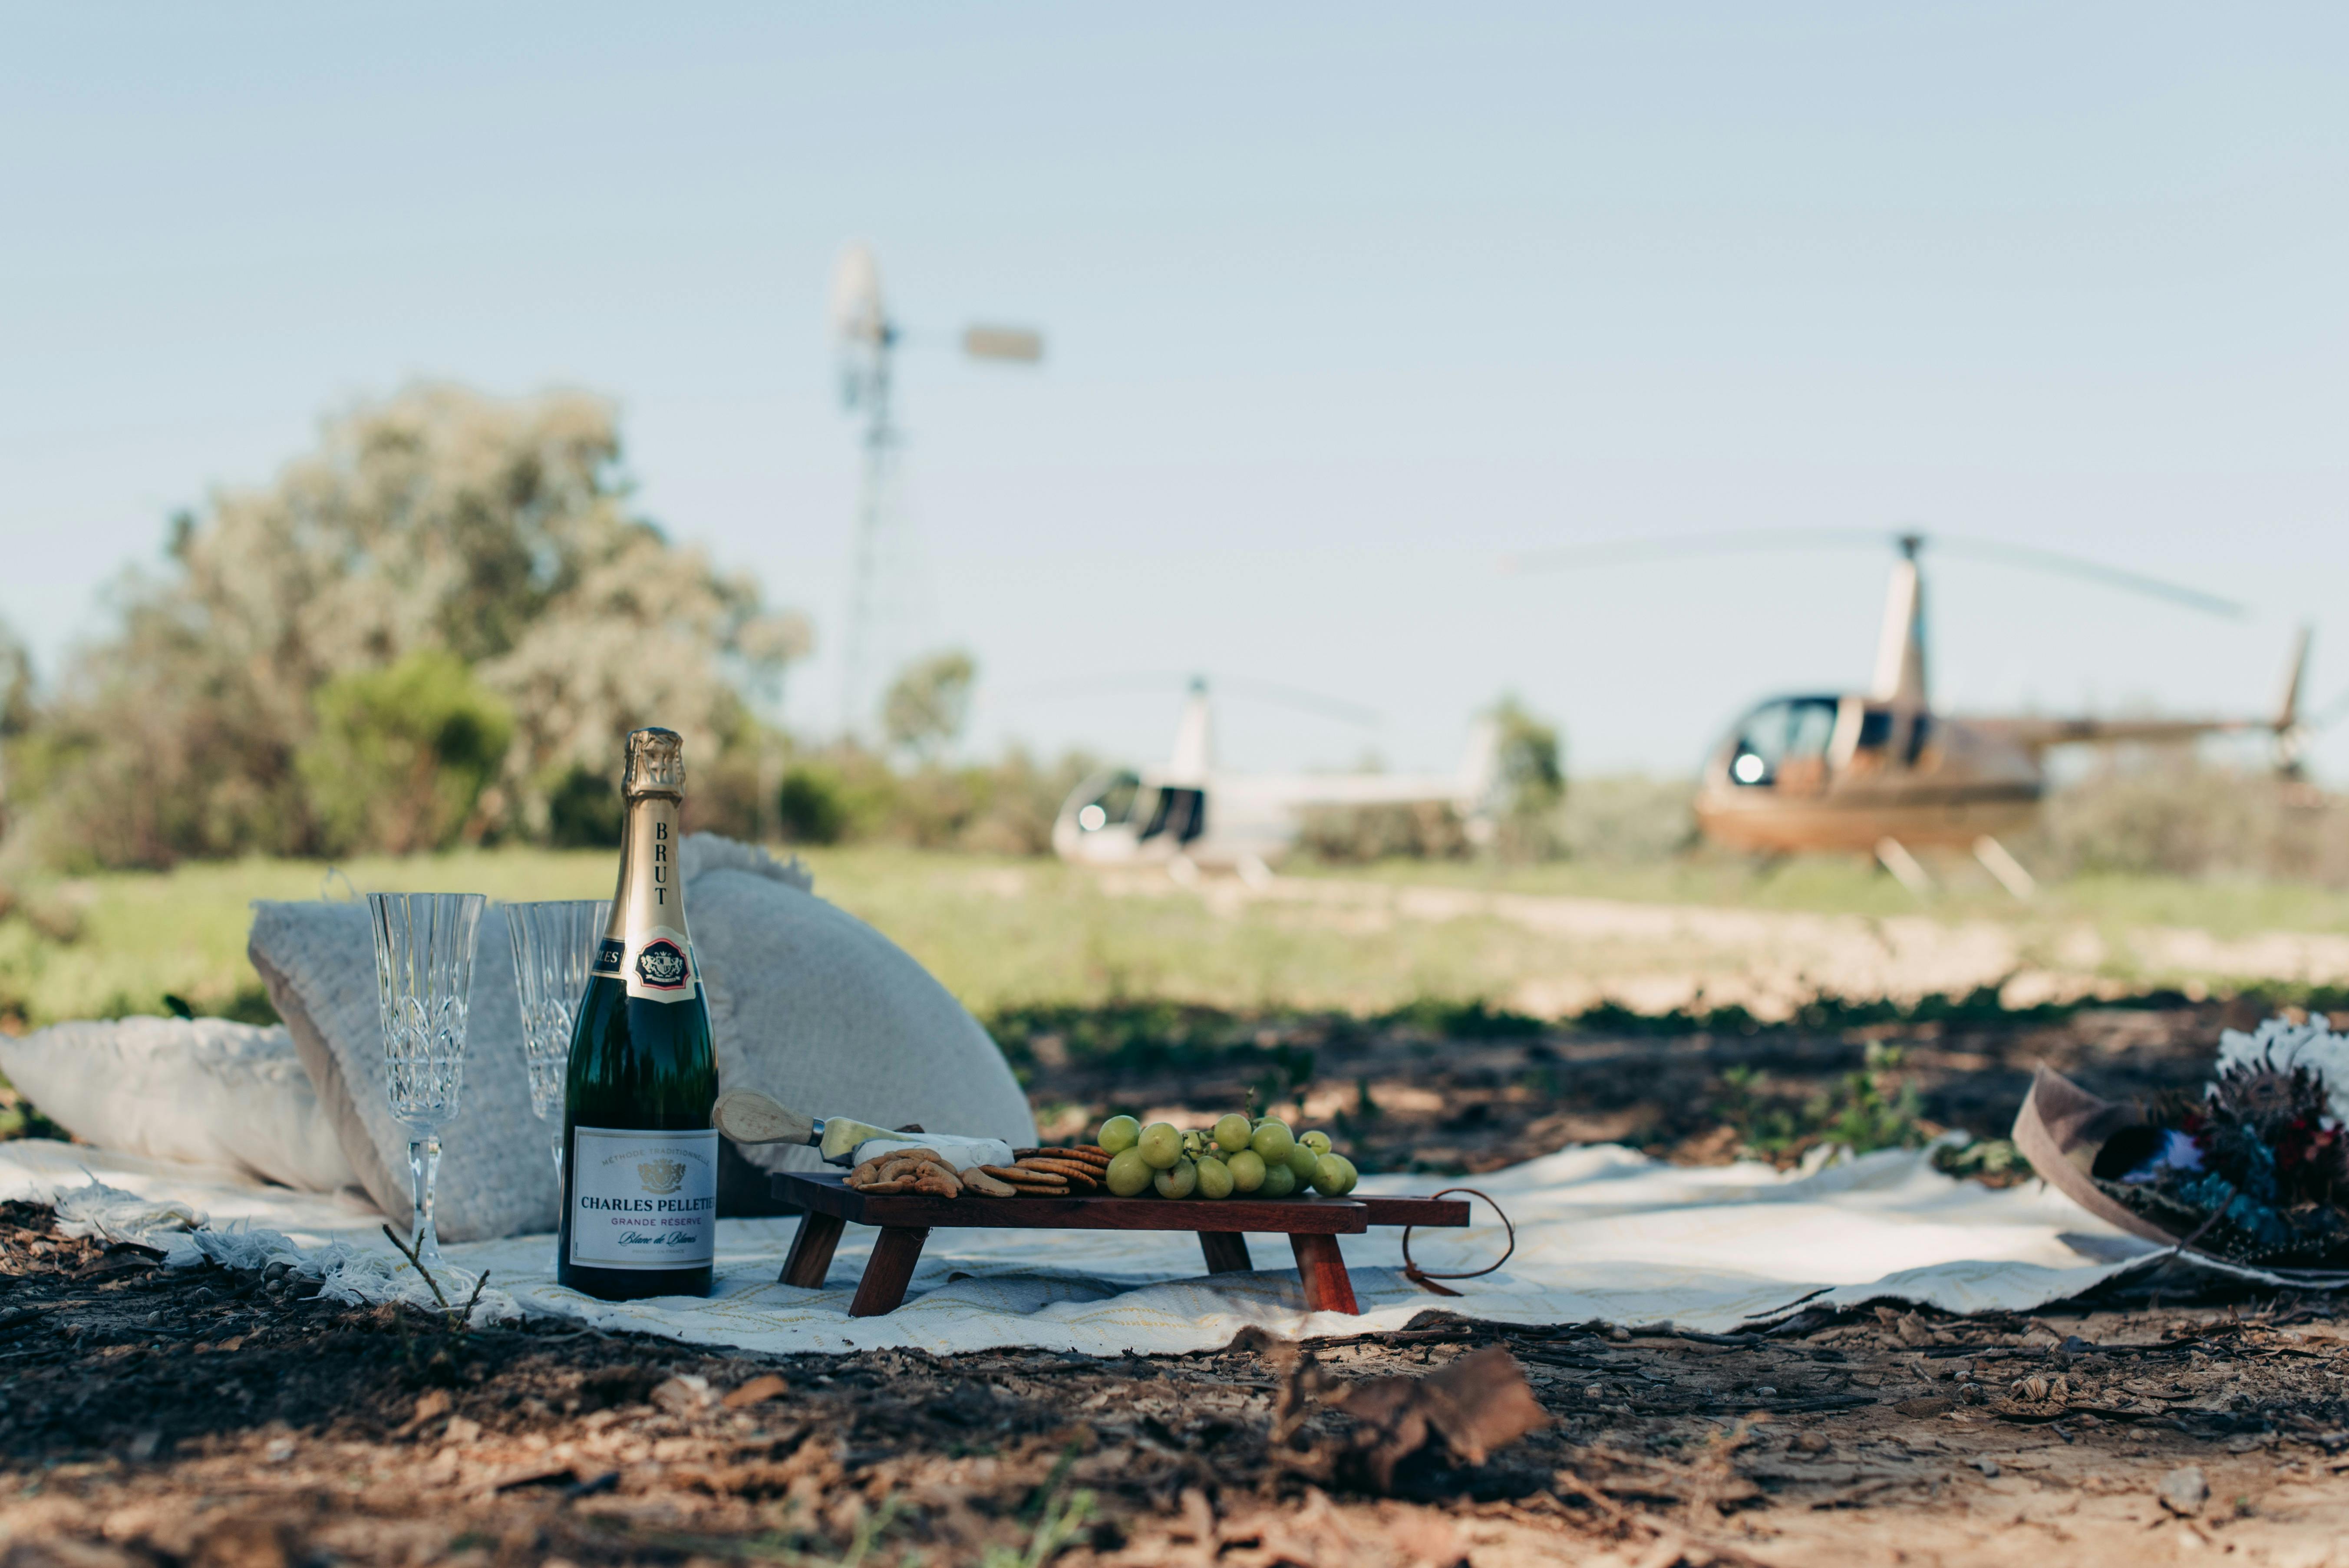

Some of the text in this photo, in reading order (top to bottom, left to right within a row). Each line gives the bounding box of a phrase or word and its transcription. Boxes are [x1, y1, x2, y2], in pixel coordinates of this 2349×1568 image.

[655, 822, 667, 905] BRUT
[650, 1148, 709, 1167] TRADITIONNELLE
[581, 1196, 653, 1211] CHARLES
[611, 1217, 702, 1226] GRANDE RÉSERVE
[618, 1231, 652, 1247] Blanc
[653, 1234, 666, 1244] de
